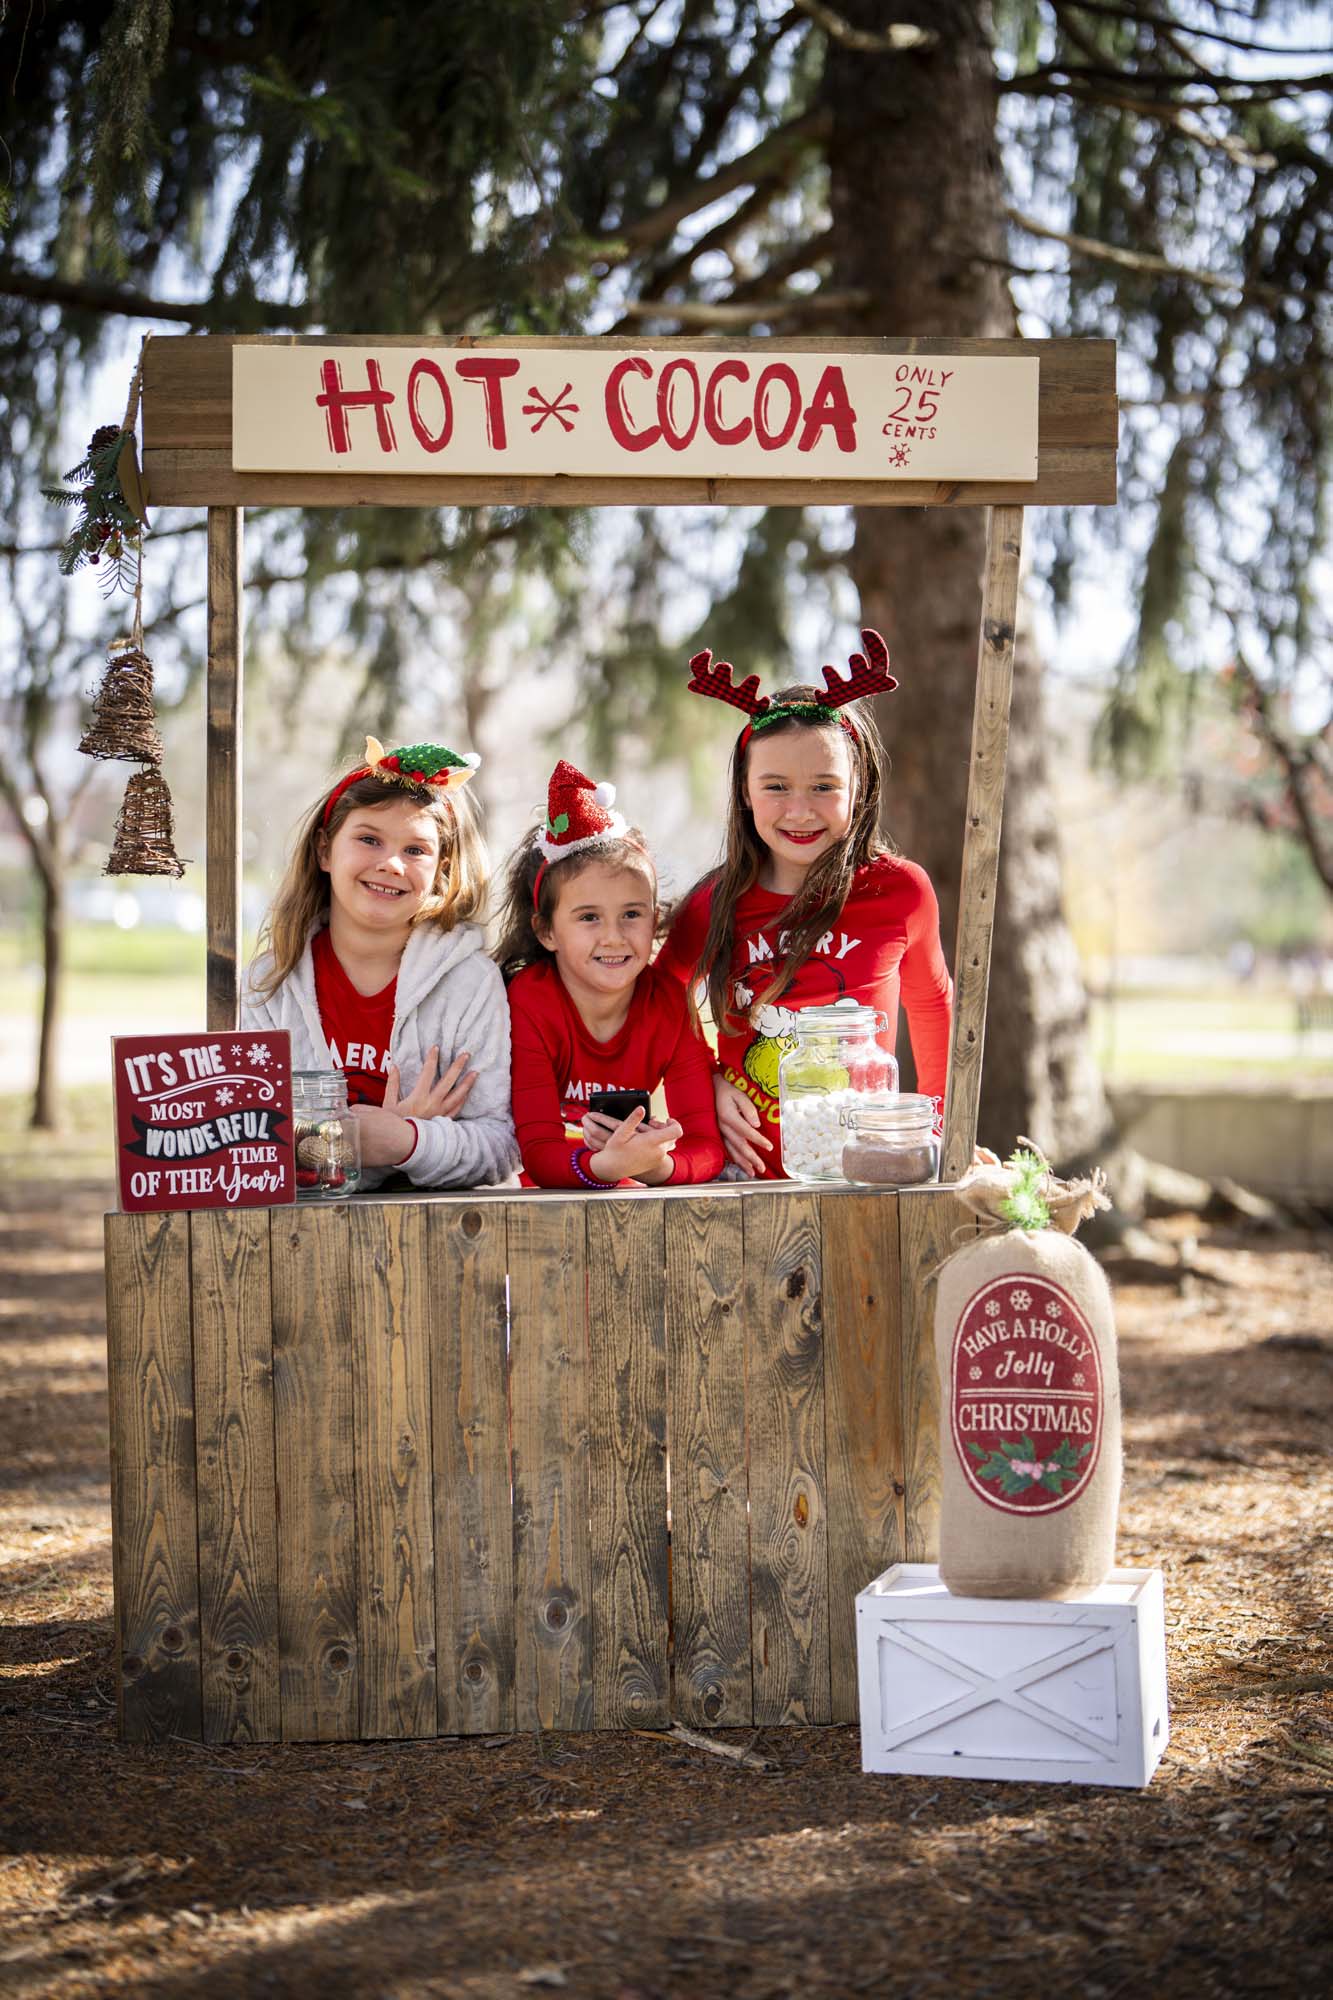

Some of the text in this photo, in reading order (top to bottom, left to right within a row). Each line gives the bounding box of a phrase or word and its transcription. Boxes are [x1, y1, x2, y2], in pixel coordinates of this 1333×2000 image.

[895, 364, 954, 387] ONLY
[315, 357, 857, 453] HOT COCOA
[888, 386, 940, 422] 25
[882, 423, 937, 440] CENTS
[124, 1044, 226, 1095] IT'S THE
[150, 1102, 206, 1122] MOST
[145, 1111, 270, 1157] WONDERFUL
[228, 1146, 278, 1165] TIME
[130, 1165, 285, 1203] OF THE Year!
[962, 1318, 1092, 1361] HAVE A HOLLY
[995, 1350, 1055, 1387] Jolly
[959, 1403, 1093, 1435] CHRISTMAS
